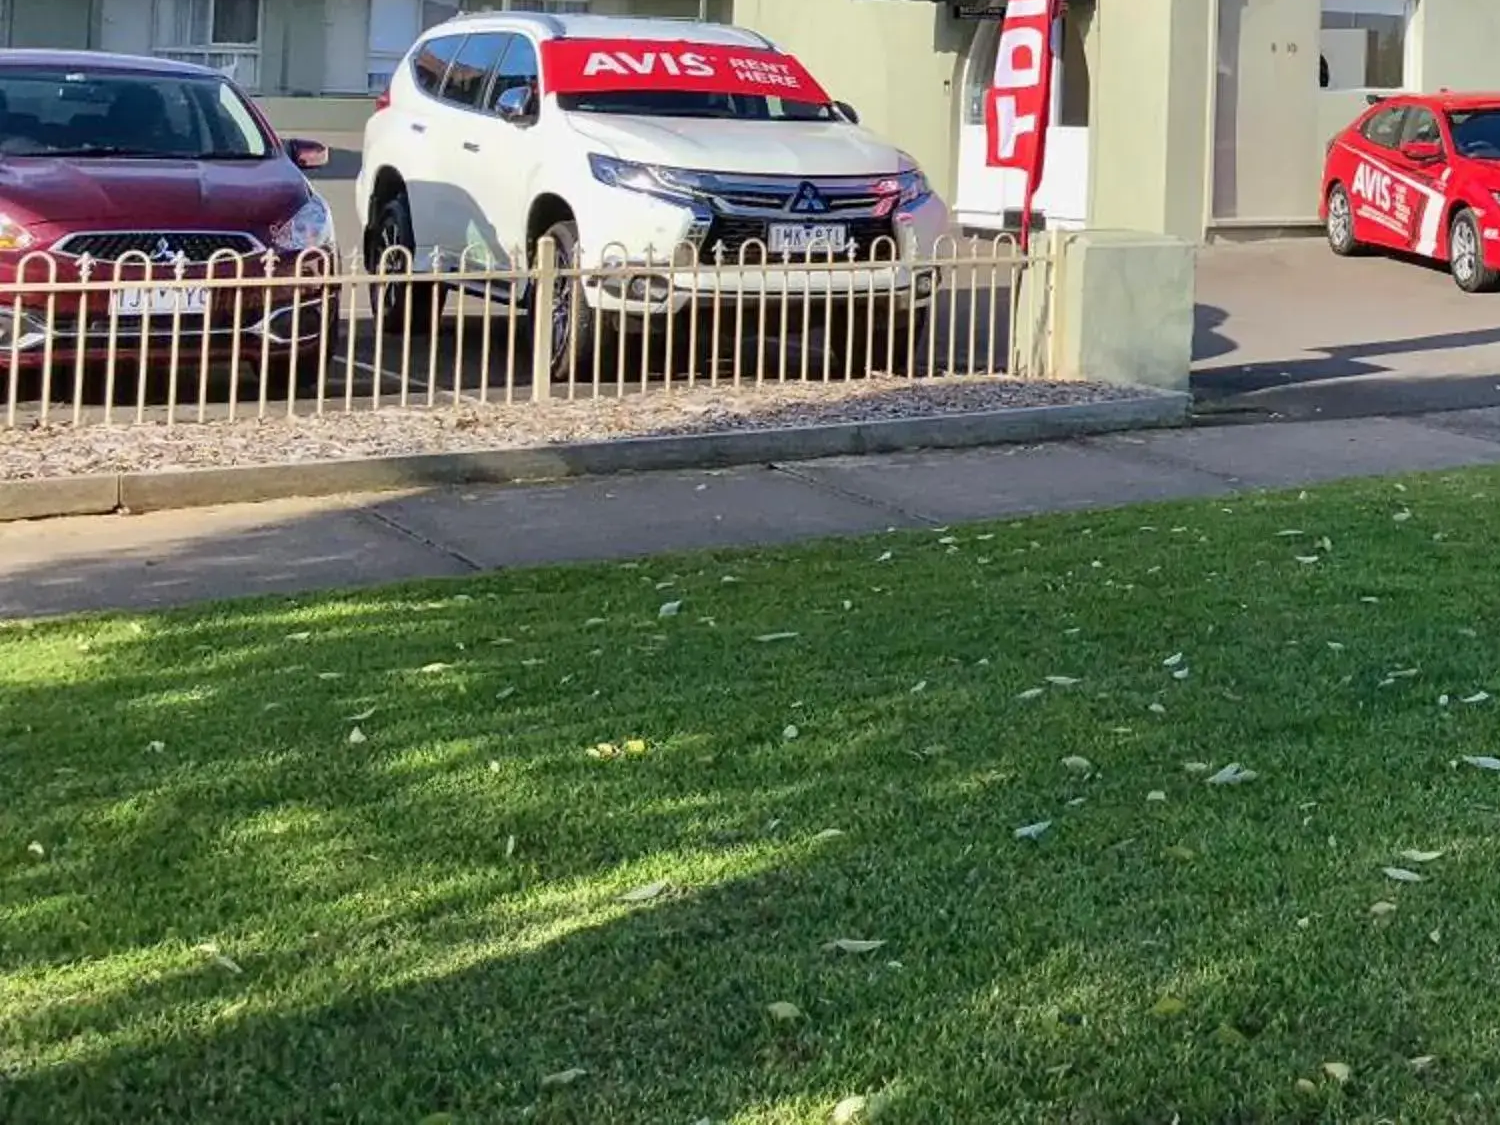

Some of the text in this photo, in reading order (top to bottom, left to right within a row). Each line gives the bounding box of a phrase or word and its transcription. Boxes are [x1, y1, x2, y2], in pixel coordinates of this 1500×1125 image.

[583, 51, 715, 76] AVIS
[728, 58, 790, 76] RENT
[738, 69, 800, 88] HERE
[1351, 161, 1392, 212] AVIS
